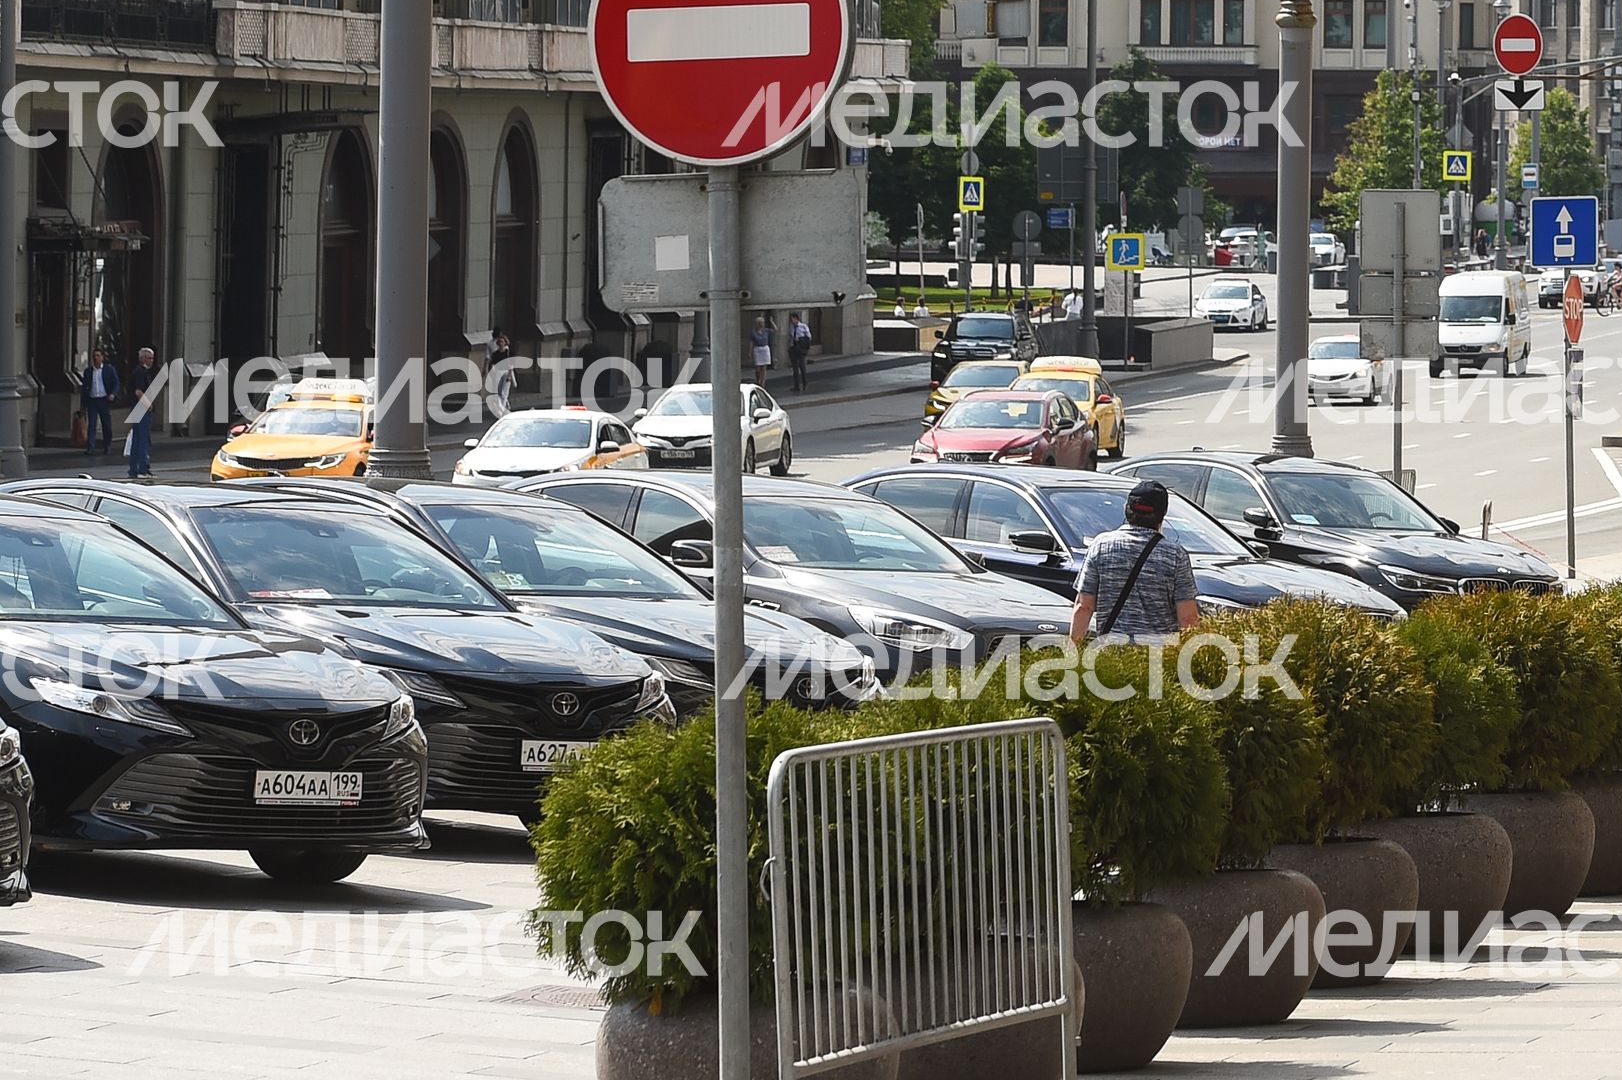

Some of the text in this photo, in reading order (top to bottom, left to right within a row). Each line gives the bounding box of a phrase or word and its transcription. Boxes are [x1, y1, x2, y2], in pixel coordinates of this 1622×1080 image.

[1564, 298, 1583, 321] STOP
[261, 773, 358, 796] А604АА 199
